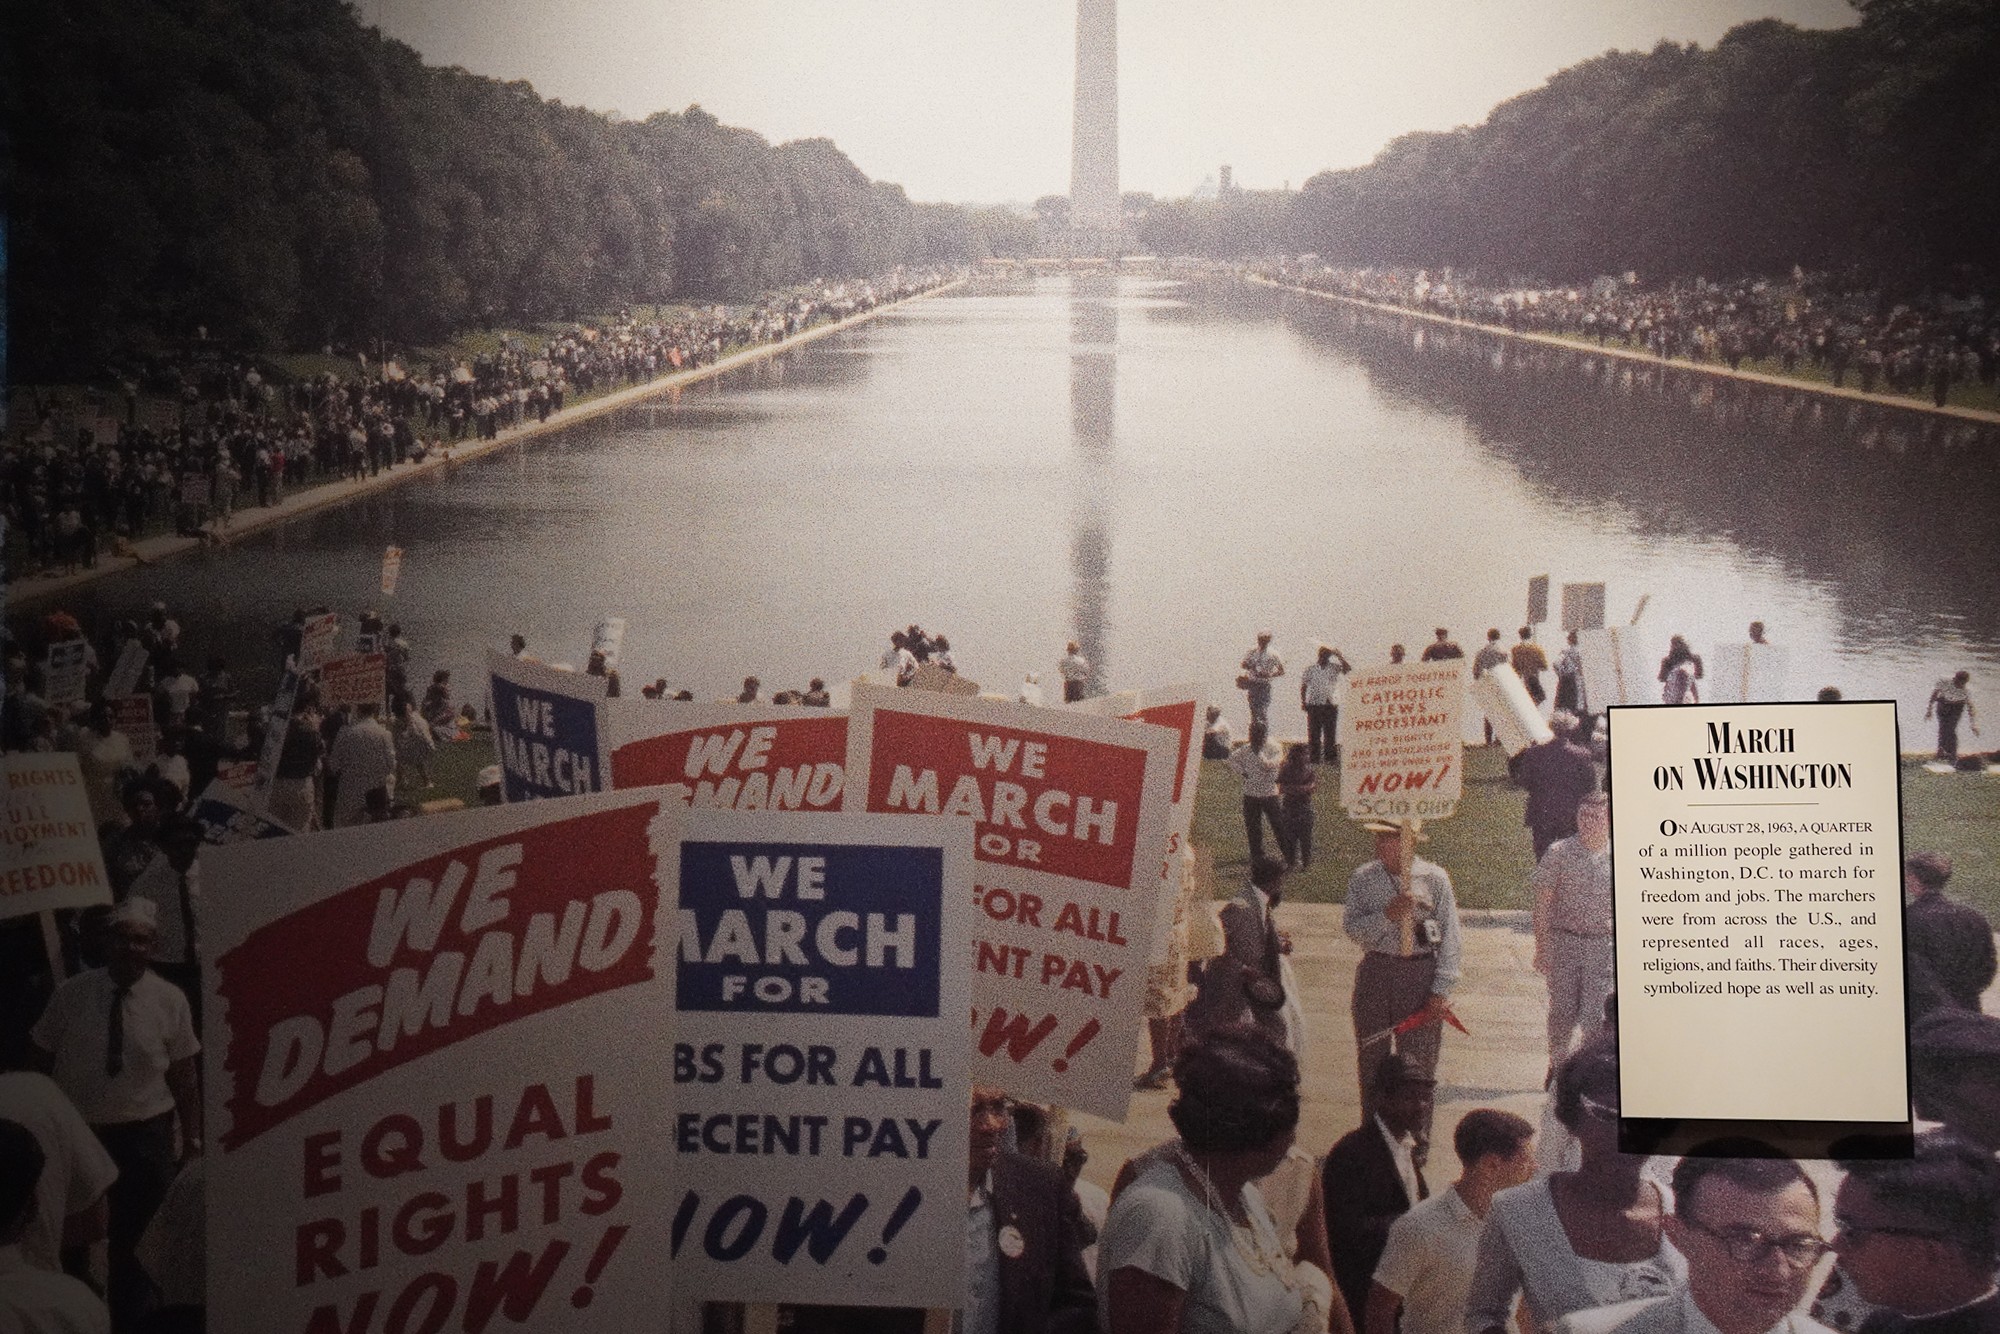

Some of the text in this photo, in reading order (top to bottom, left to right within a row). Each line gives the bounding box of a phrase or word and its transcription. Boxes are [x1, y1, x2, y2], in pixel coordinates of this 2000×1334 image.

[1361, 687, 1444, 704] CATHOLIC
[1377, 702, 1425, 715] JEWS
[517, 695, 555, 737] WE
[1356, 714, 1447, 731] PROTESTANT
[684, 727, 777, 778] WE
[1707, 721, 1795, 754] MARCH
[501, 729, 592, 794] MARCH
[968, 732, 1048, 779] WE
[8, 768, 76, 789] RIGHTS
[682, 763, 844, 810] MAND
[1358, 763, 1450, 795] NOW!
[1653, 757, 1852, 791] ON WASHINGTON
[887, 764, 1118, 845] MARCH
[0, 822, 87, 845] LOYMENT
[1659, 819, 1873, 837] ON AUGUST 28, 1963, A QUARTER
[979, 834, 1043, 863] OR
[1638, 842, 1874, 860] of a million people gathered in
[731, 855, 826, 899] WE
[1639, 865, 1876, 884] Washington, D.C. to march for
[366, 843, 524, 969] WE
[1641, 888, 1876, 906] freedom and jobs. The marchers
[974, 885, 1127, 947] OR ALL
[1641, 912, 1877, 926] were from across the U.S., and
[1642, 935, 1879, 952] represented all races, ages,
[1041, 956, 1124, 999] PAY
[1643, 958, 1878, 976] religions, and faiths. Their diversity
[254, 890, 643, 1108] DEMAND
[722, 975, 830, 1004] FOR
[1643, 980, 1879, 999] symbolized hope as well as unity.
[675, 1044, 942, 1089] BS FOR ALL
[303, 1075, 613, 1199] EQUAL
[673, 1113, 943, 1159] ECENT PAY
[296, 1152, 624, 1287] RIGHTS
[302, 1225, 630, 1334] NOW!
